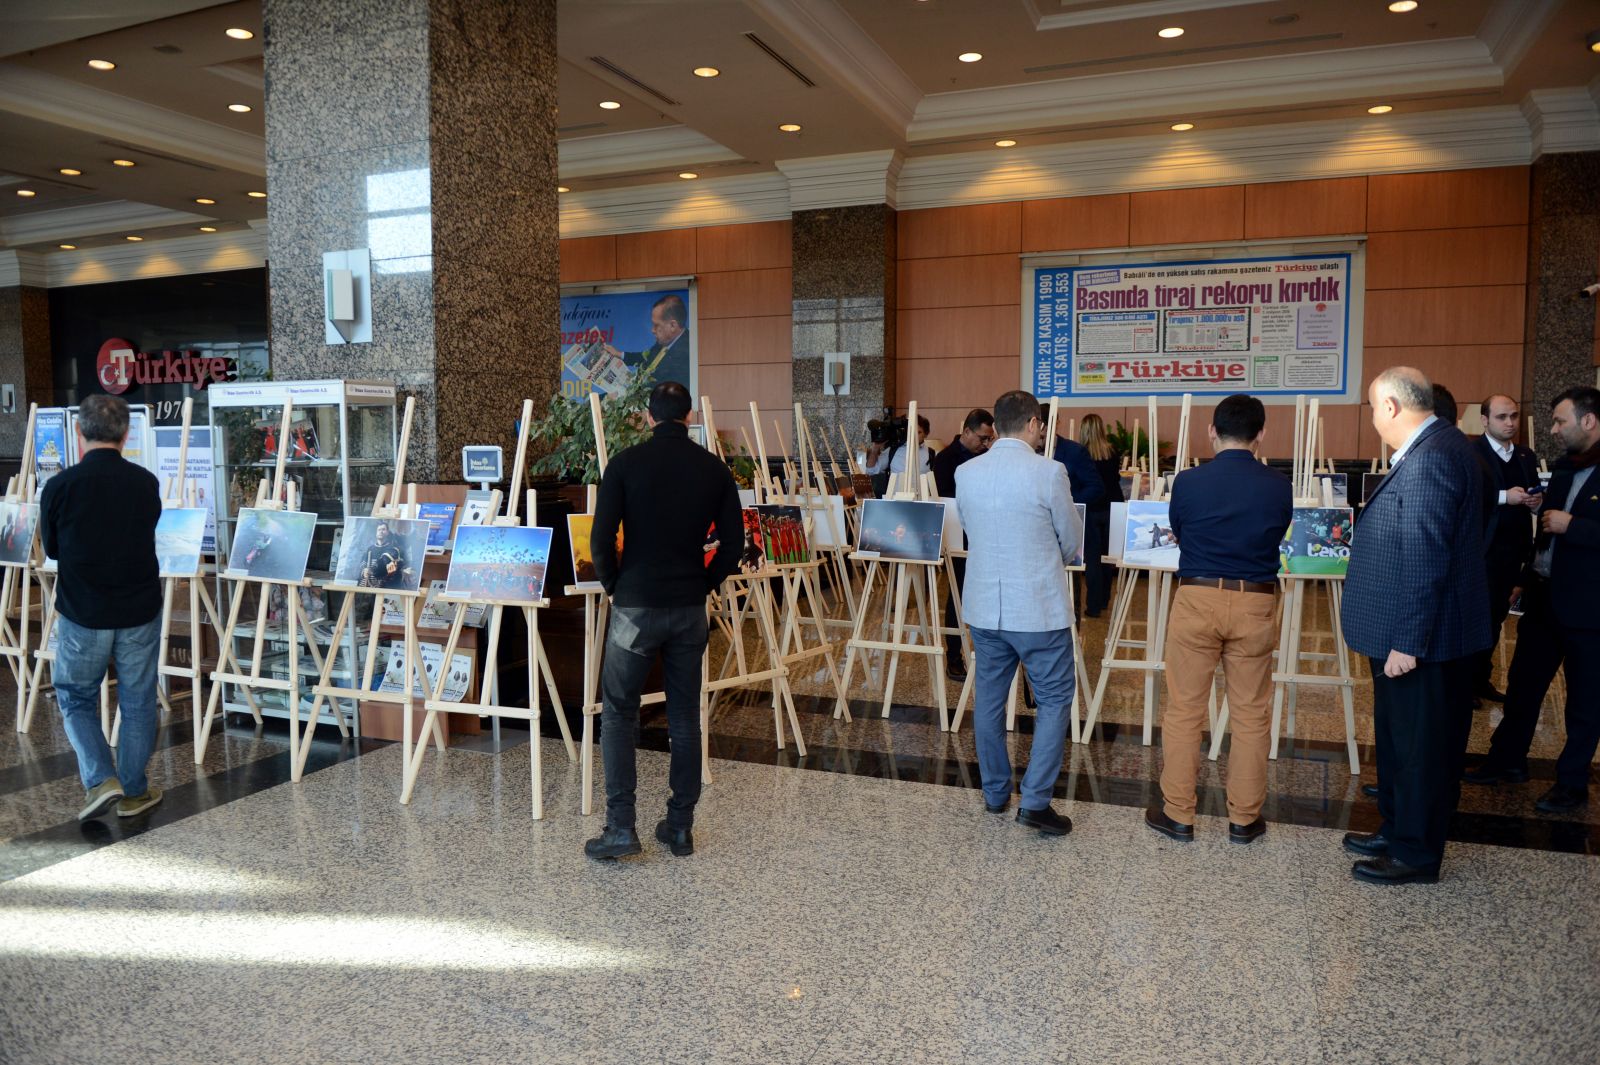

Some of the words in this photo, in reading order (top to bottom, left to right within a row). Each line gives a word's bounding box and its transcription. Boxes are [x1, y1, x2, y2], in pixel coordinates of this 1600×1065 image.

[1275, 264, 1318, 272] Türkiye
[1039, 274, 1053, 300] 1990
[1055, 272, 1070, 328] 1.361.553
[1077, 284, 1149, 311] Basında
[1154, 283, 1196, 310] tiraj
[1201, 281, 1273, 306] rekoru
[1278, 276, 1340, 303] kırdık
[563, 303, 612, 327] rdoğan:
[1039, 303, 1052, 339] KASIM
[561, 326, 615, 345] azetesi
[1039, 341, 1052, 355] 29
[1054, 332, 1071, 369] SATIŞ:
[110, 349, 227, 390] Türkiye
[1036, 357, 1052, 394] TARİH:
[1054, 372, 1068, 393] NET
[1108, 359, 1246, 384] Türkiye
